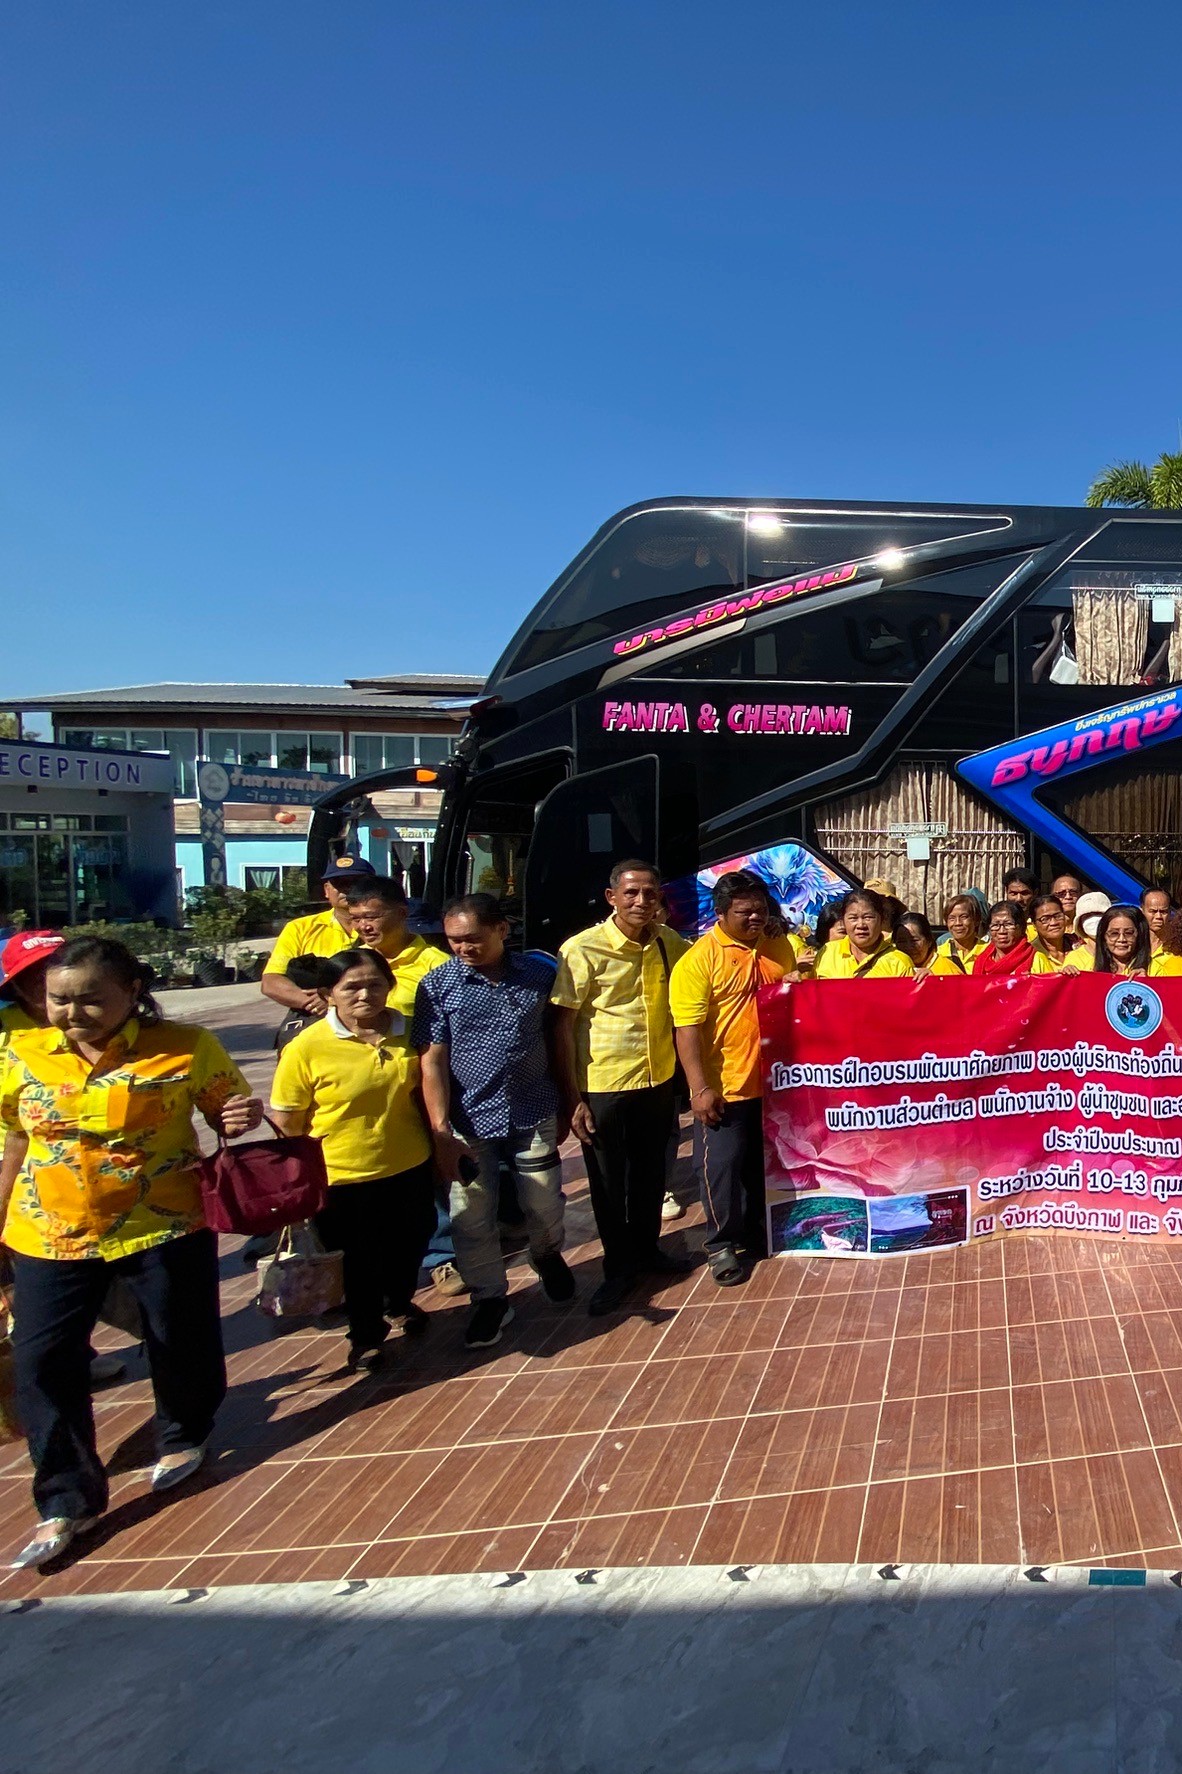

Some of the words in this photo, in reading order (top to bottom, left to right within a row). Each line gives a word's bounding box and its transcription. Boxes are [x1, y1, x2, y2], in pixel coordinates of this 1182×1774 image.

[602, 702, 689, 732] FANTA
[698, 703, 720, 733] &
[727, 704, 852, 735] CHERTAM
[773, 1053, 1032, 1088] โครงการฝึกอบรมพัฒนาศักยภาพ
[1040, 1044, 1182, 1076] ของผู้บริหารท้องถิ่น
[828, 1094, 974, 1128] พนักงานส่วนตำบล
[981, 1086, 1073, 1113] พนักงานจ้าง
[1080, 1086, 1147, 1116] ผู้นำชุมชน
[1045, 1129, 1179, 1155] ประจำปีงบประมาณ
[980, 1163, 1080, 1195] ระหว่างวันที่
[1089, 1172, 1146, 1191] 10-13
[976, 1216, 994, 1233] ณ
[1130, 1213, 1157, 1230] และ
